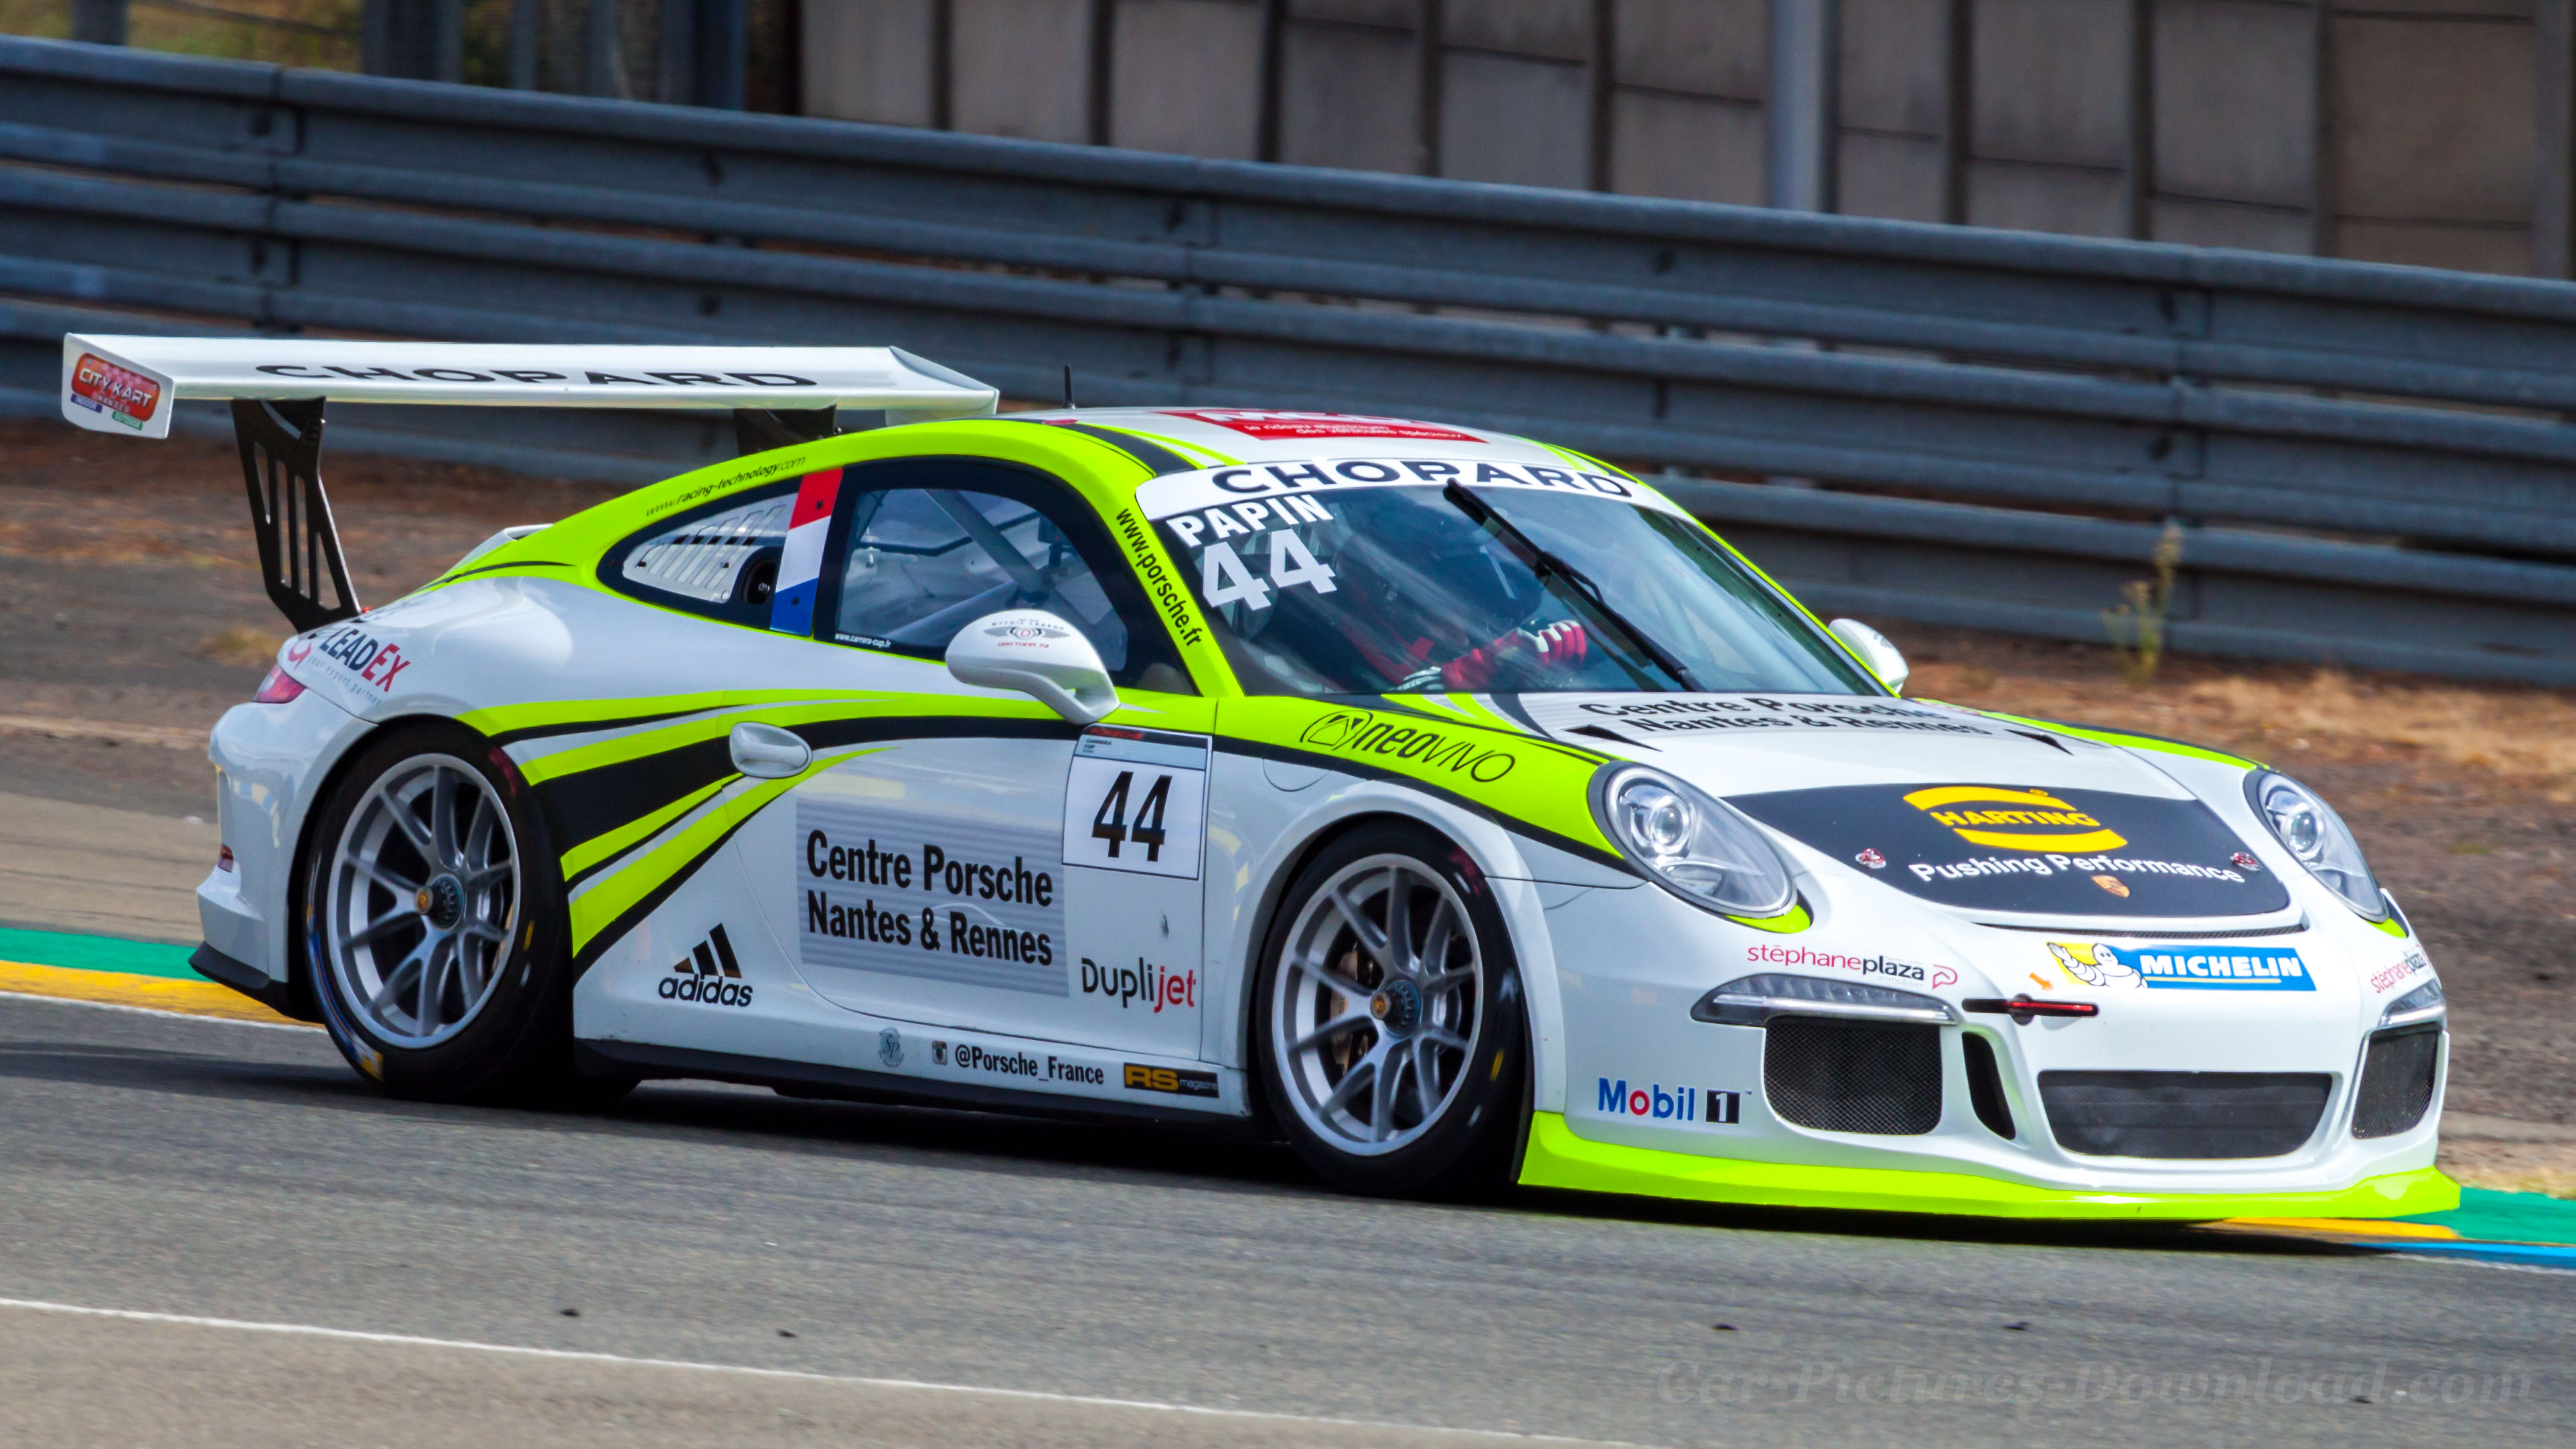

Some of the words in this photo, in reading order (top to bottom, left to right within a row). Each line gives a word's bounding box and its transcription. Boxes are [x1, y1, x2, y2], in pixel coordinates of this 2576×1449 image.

[79, 368, 112, 392] CITY
[112, 382, 153, 408] KART
[255, 365, 817, 386] CHOPARD
[646, 457, 806, 517] www.racing-technology.com
[1213, 461, 1632, 498] CHOPARD
[1166, 494, 1334, 548] PAPIN
[1116, 508, 1203, 646] www.porsche.fr
[1203, 529, 1337, 611] 44
[1578, 700, 1752, 715] Centre
[1742, 698, 1950, 720] Porsche
[1619, 716, 1793, 732] Nantes
[1789, 715, 1837, 727] &
[1827, 716, 1993, 735] Rennes
[1091, 771, 1173, 862] 44
[1930, 811, 2101, 827] HARTING
[806, 829, 911, 889] Centre
[923, 844, 1053, 907] Porsche
[1909, 856, 2053, 882] Pushing
[2046, 854, 2245, 883] Performance
[808, 889, 910, 945] Nantes
[920, 907, 940, 950] &
[950, 911, 1053, 966] Rennes
[2140, 954, 2303, 977] MICHELIN
[658, 973, 753, 1007] adidas
[955, 1044, 1104, 1084] @Porsche_France
[1125, 1065, 1179, 1091] RS
[1598, 1077, 1695, 1122] Mobil
